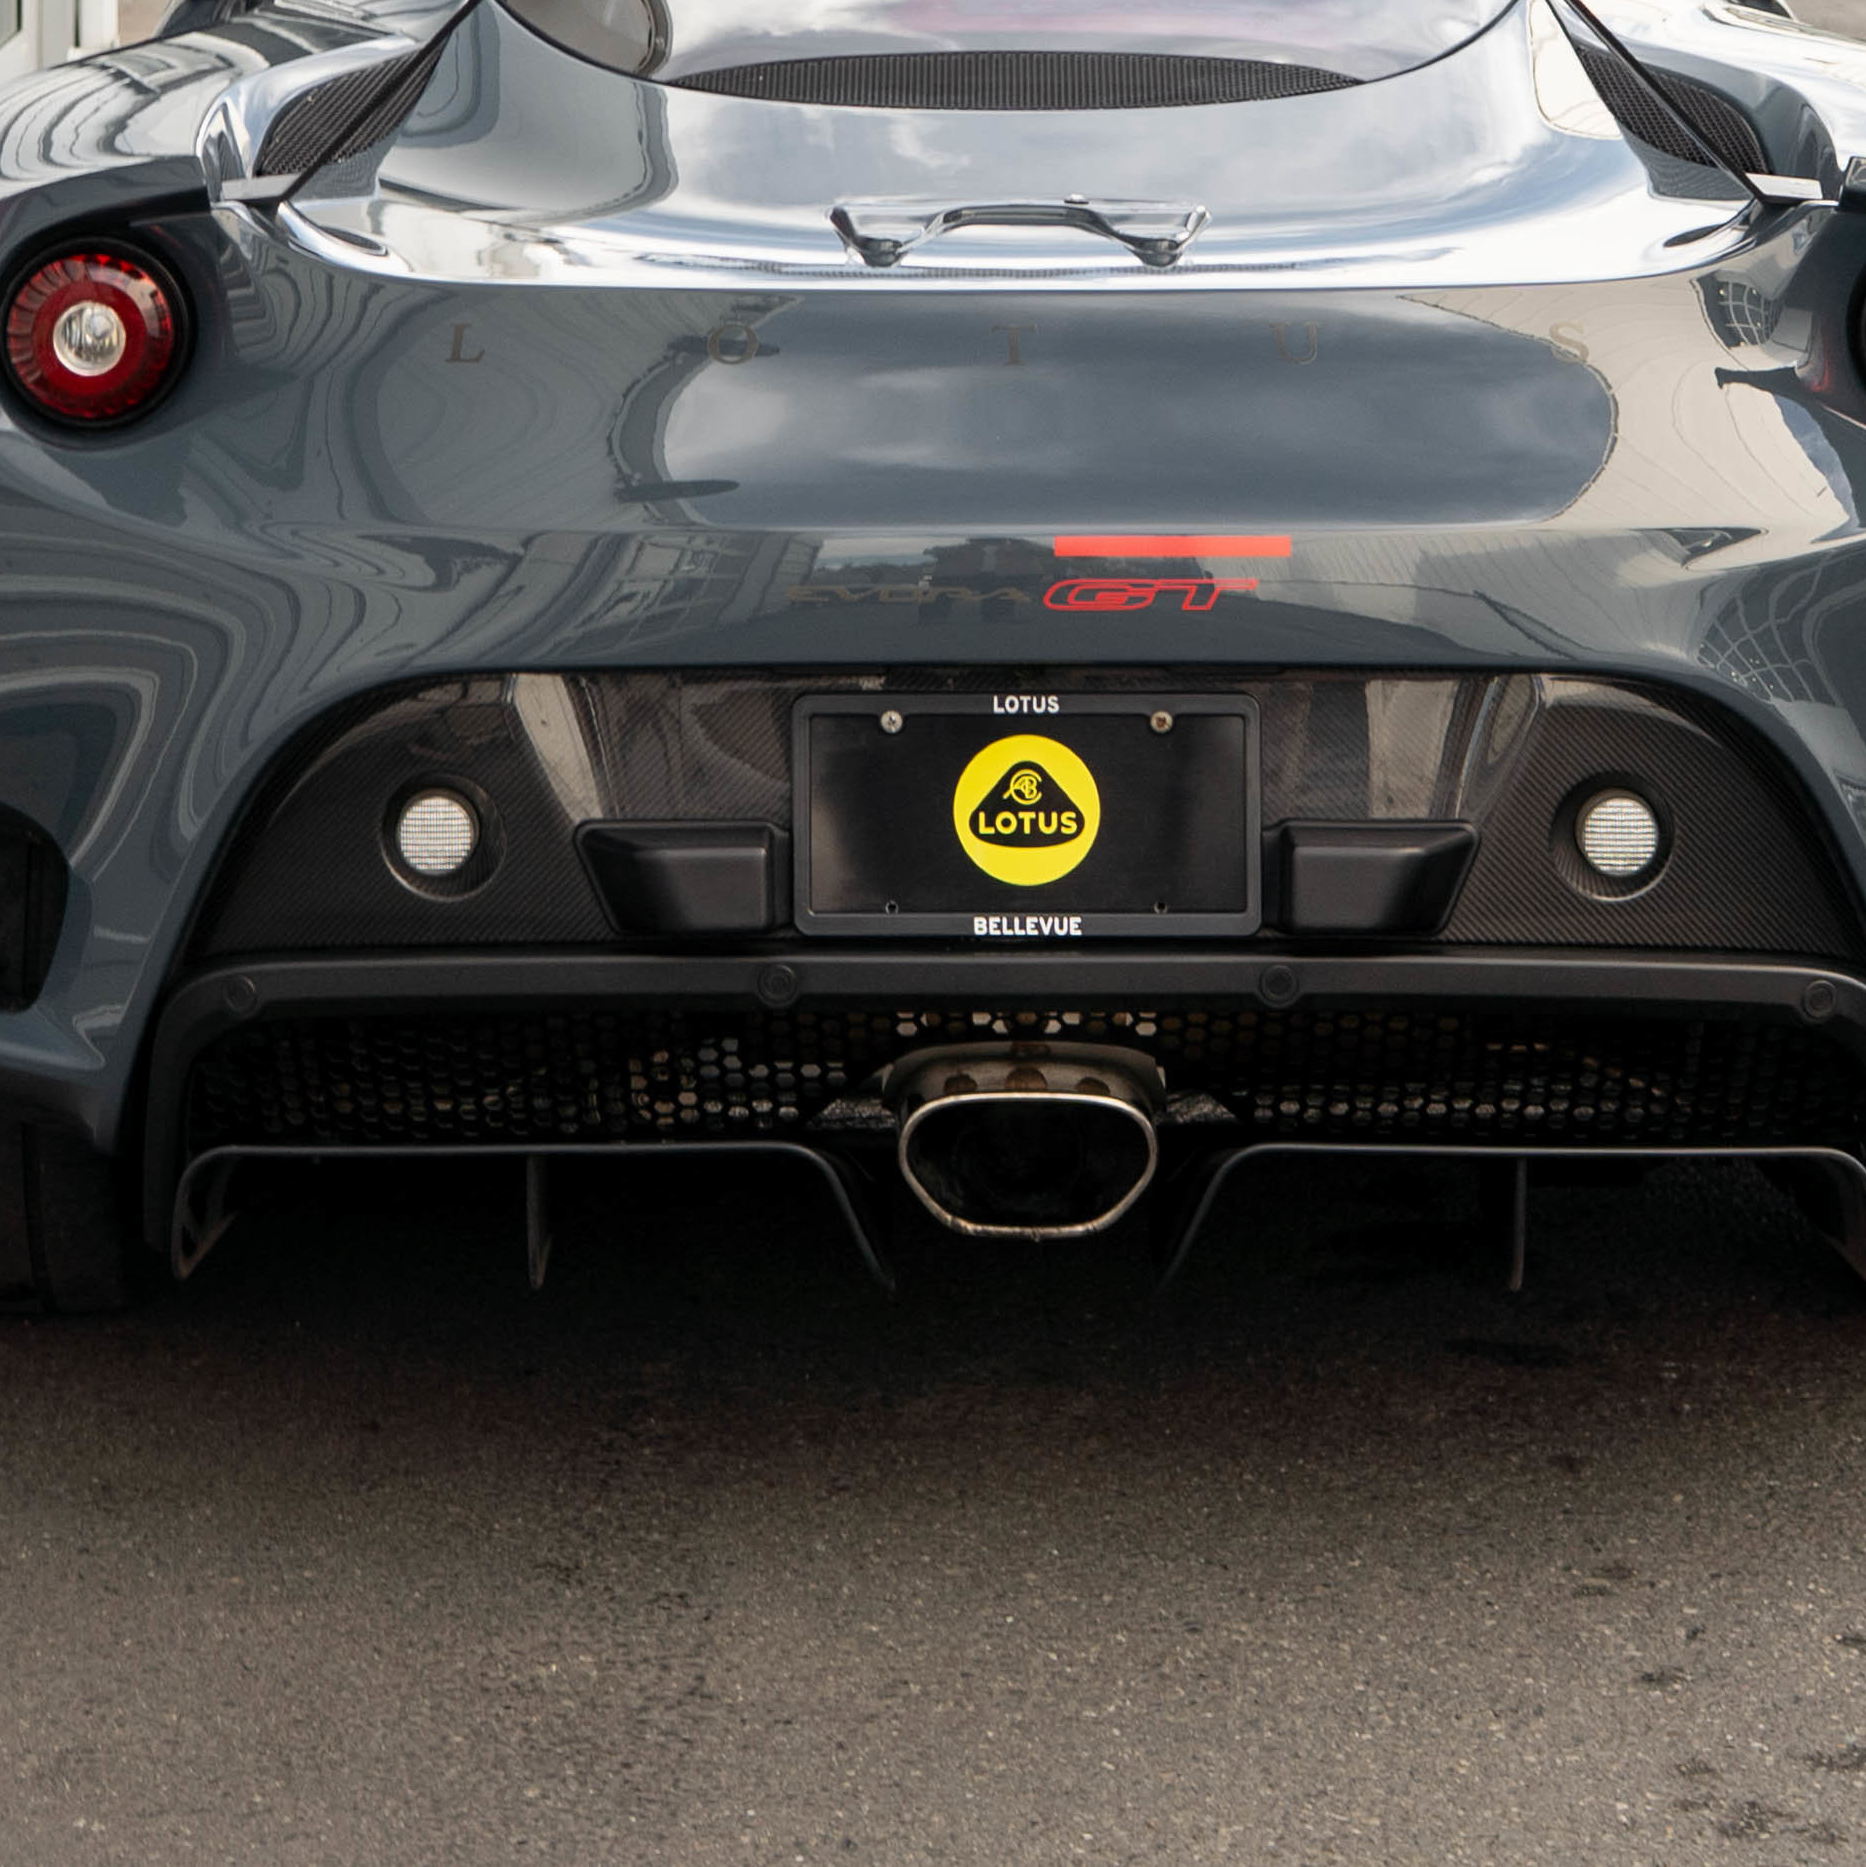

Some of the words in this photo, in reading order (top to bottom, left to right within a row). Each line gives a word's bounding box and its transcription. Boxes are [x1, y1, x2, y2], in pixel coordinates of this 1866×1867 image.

[1043, 578, 1258, 611] GT
[993, 695, 1060, 714] LOTUS
[978, 811, 1078, 835] LOTUS
[973, 916, 1082, 936] BELLEVUE
